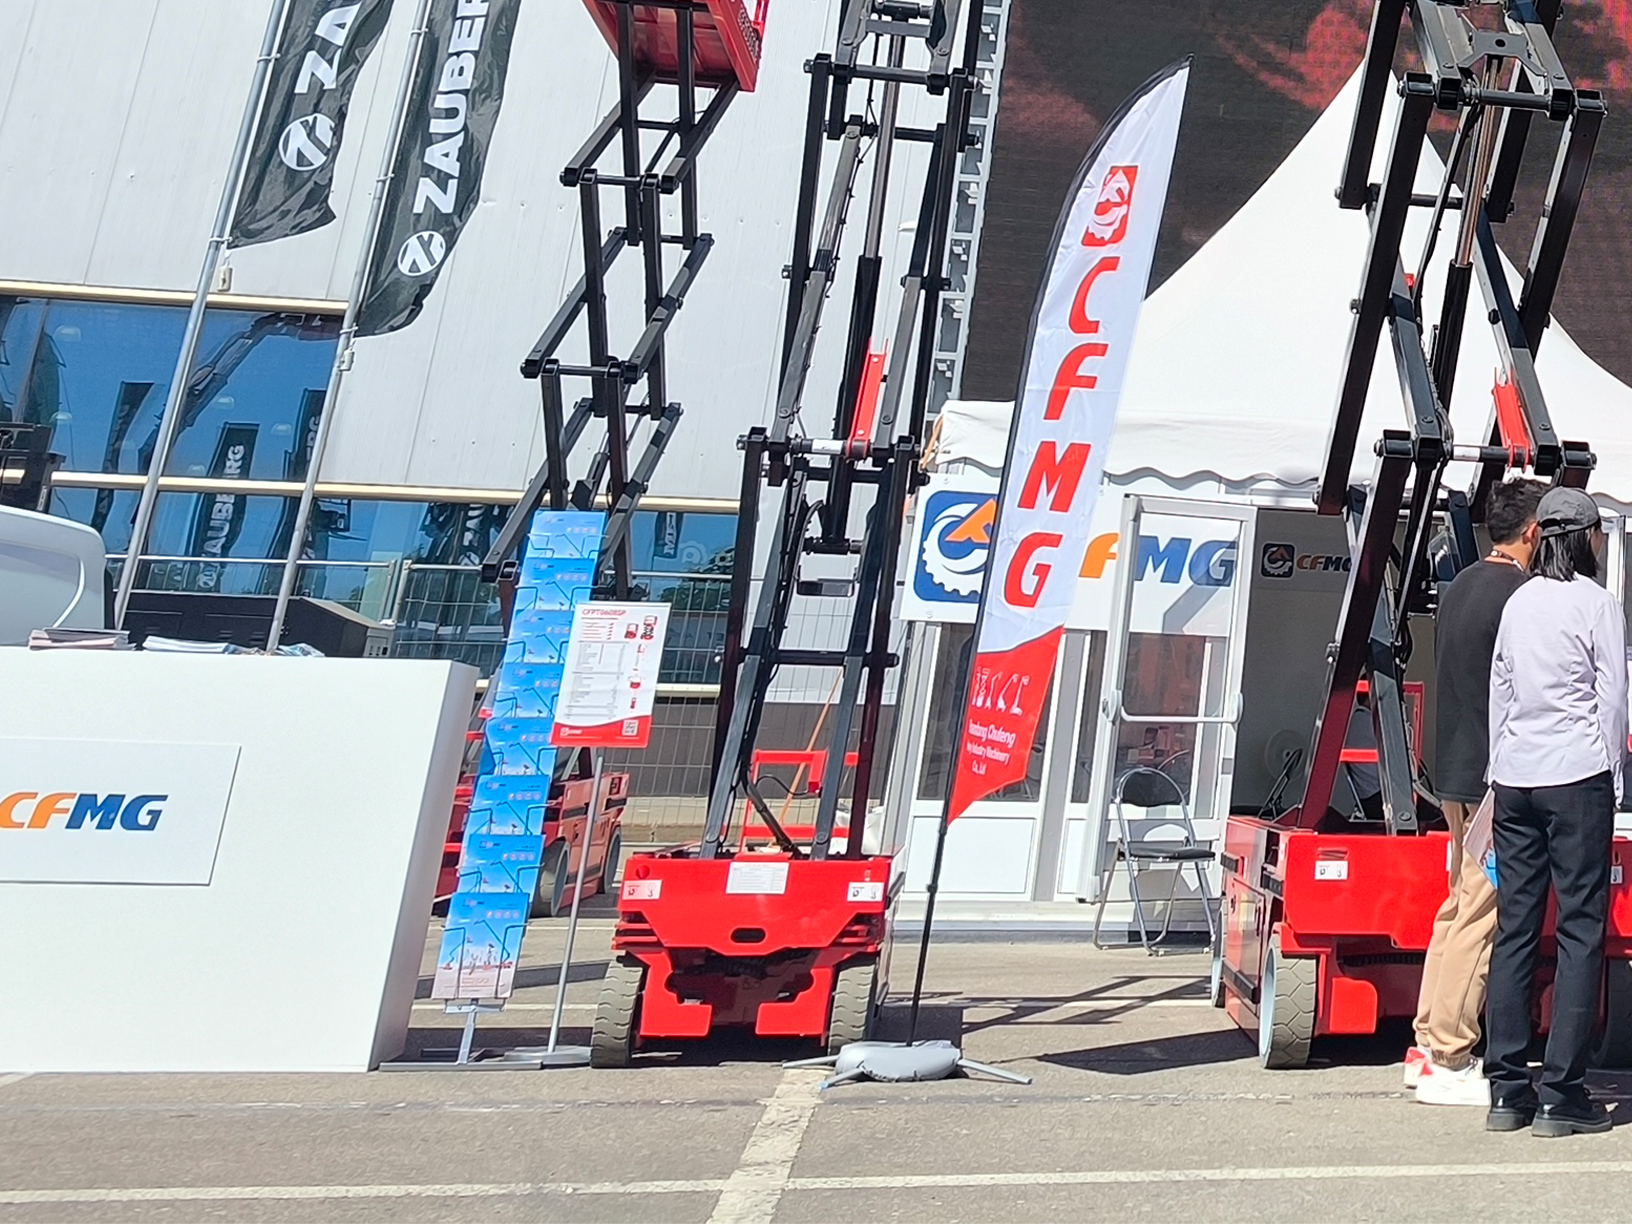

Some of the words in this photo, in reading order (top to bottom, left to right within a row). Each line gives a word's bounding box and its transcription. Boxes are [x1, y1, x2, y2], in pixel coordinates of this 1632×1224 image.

[1003, 257, 1118, 608] CFMG
[1078, 532, 1239, 587] FMG
[0, 792, 169, 831] CFMG
